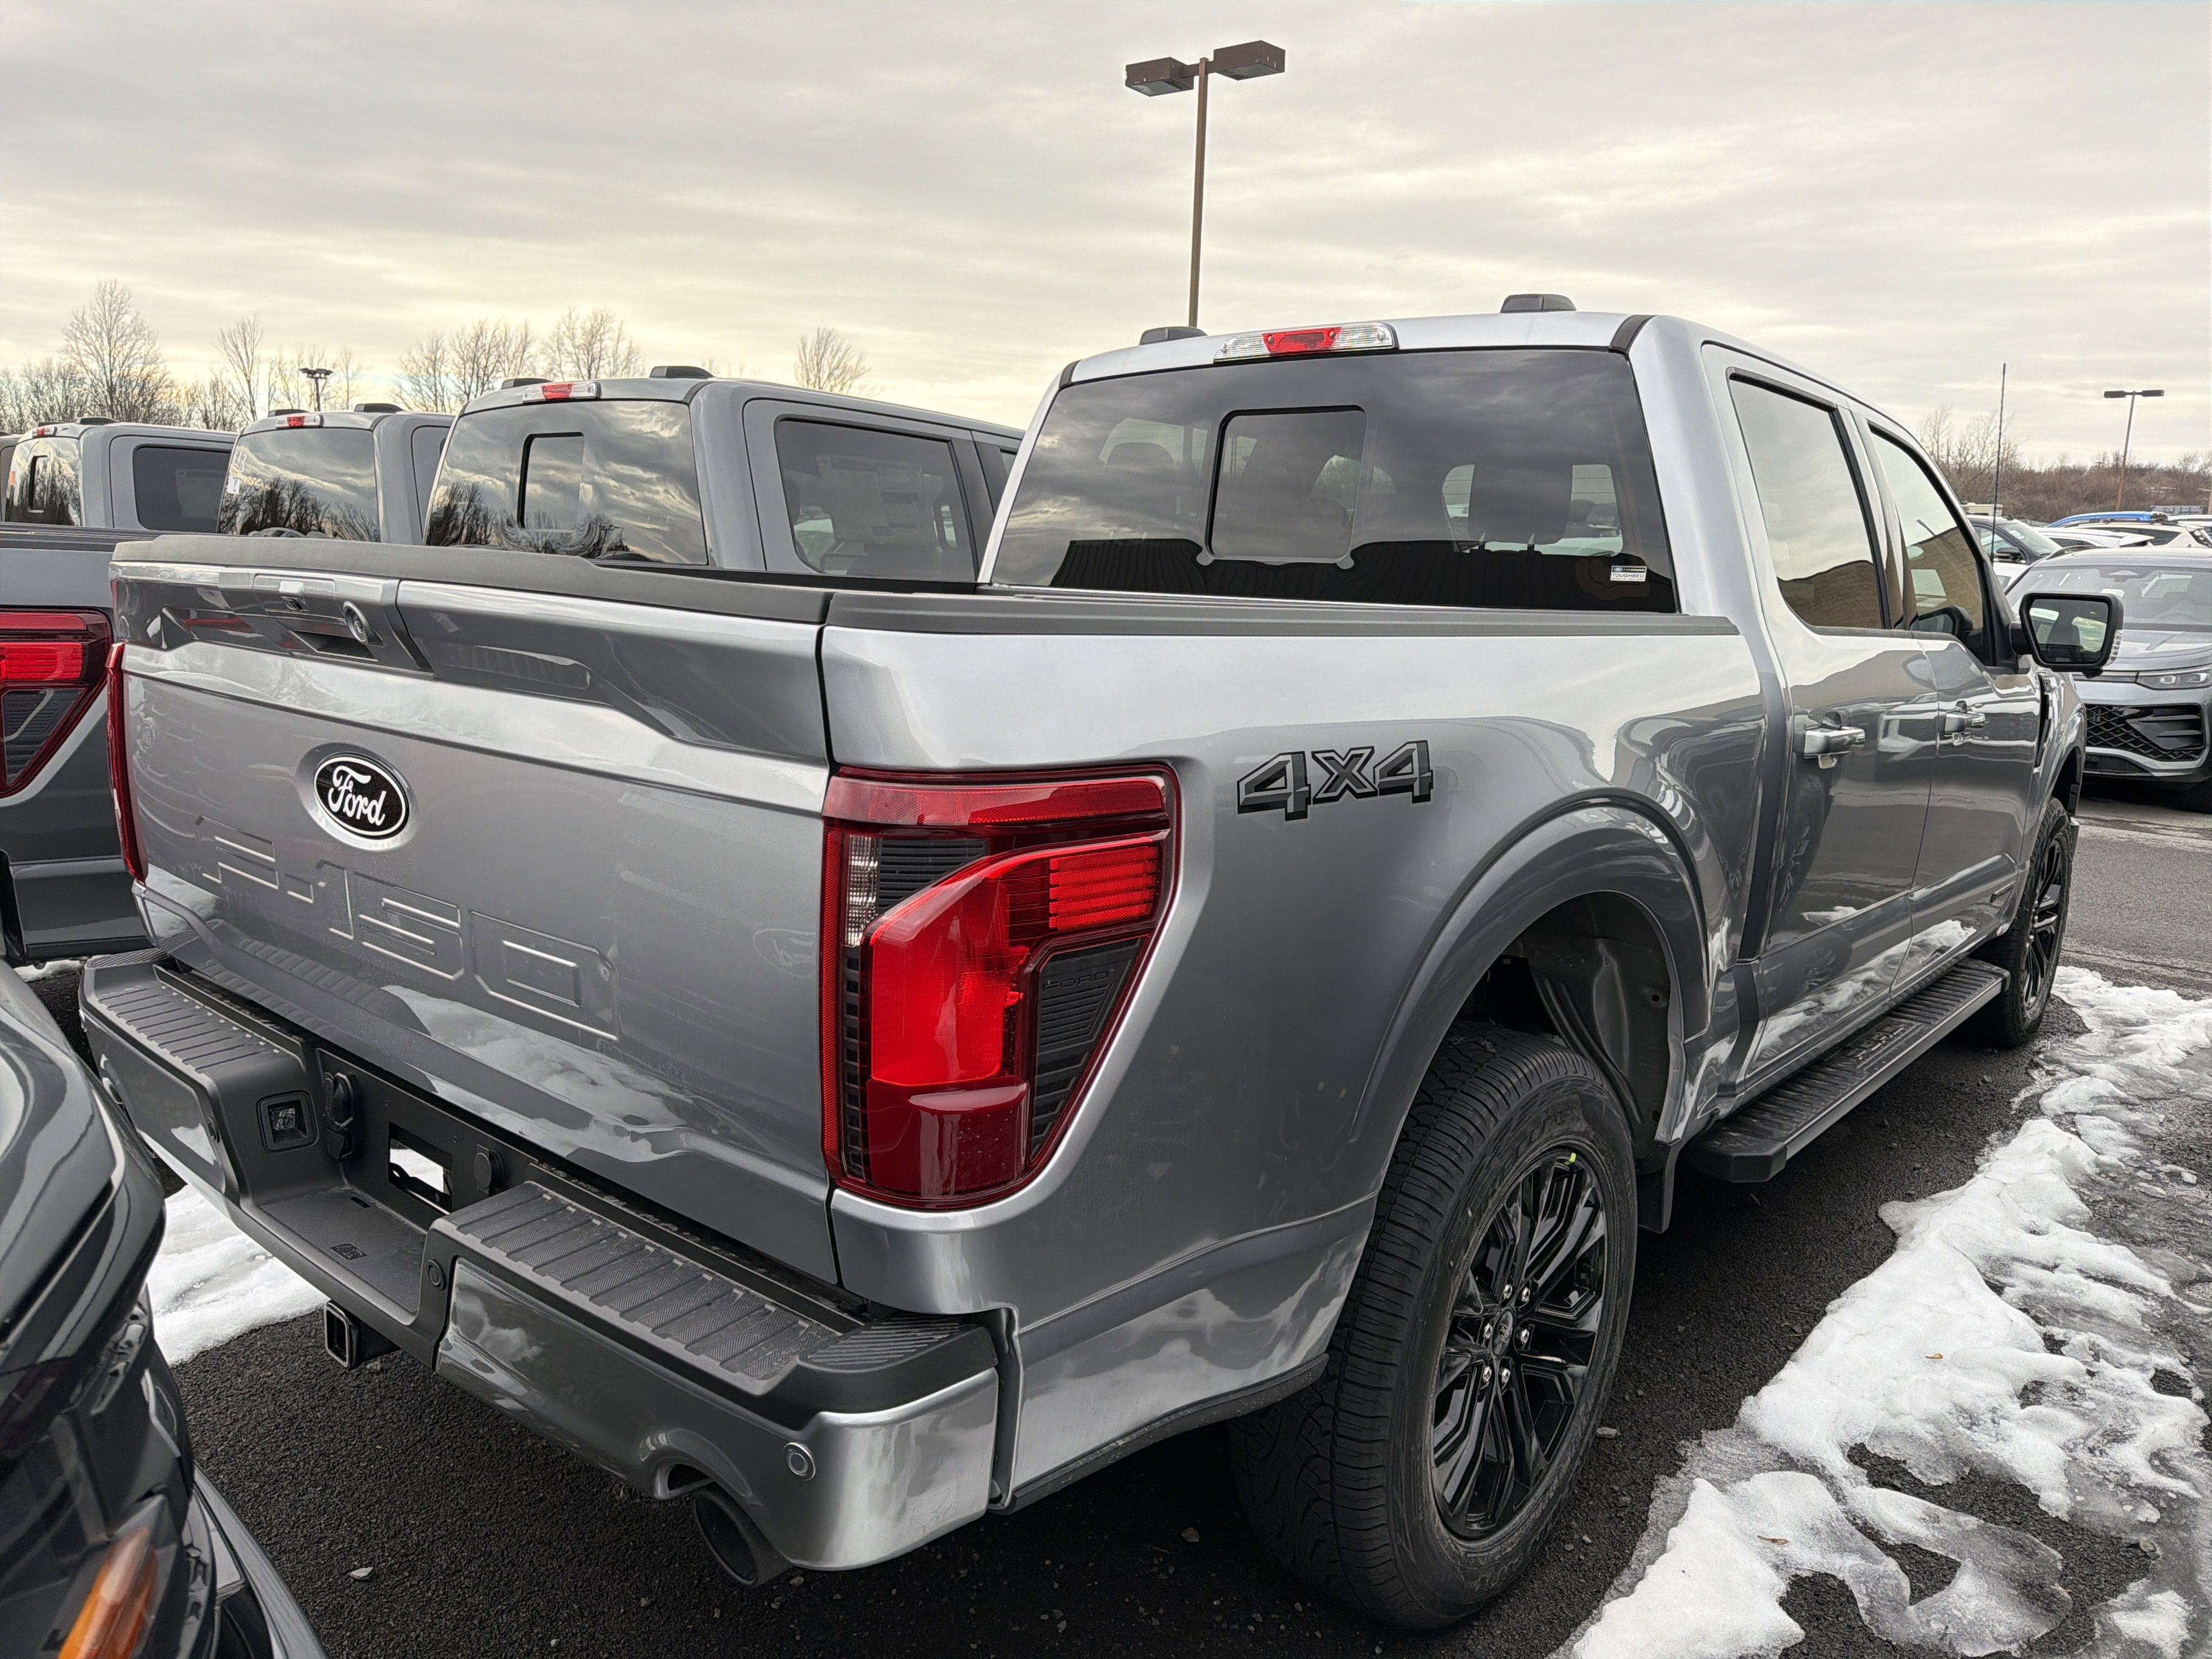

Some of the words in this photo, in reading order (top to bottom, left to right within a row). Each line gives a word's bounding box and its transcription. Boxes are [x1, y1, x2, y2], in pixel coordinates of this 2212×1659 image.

[328, 765, 385, 827] Ford
[195, 815, 620, 1041] F-150
[1042, 970, 1109, 994] FORD
